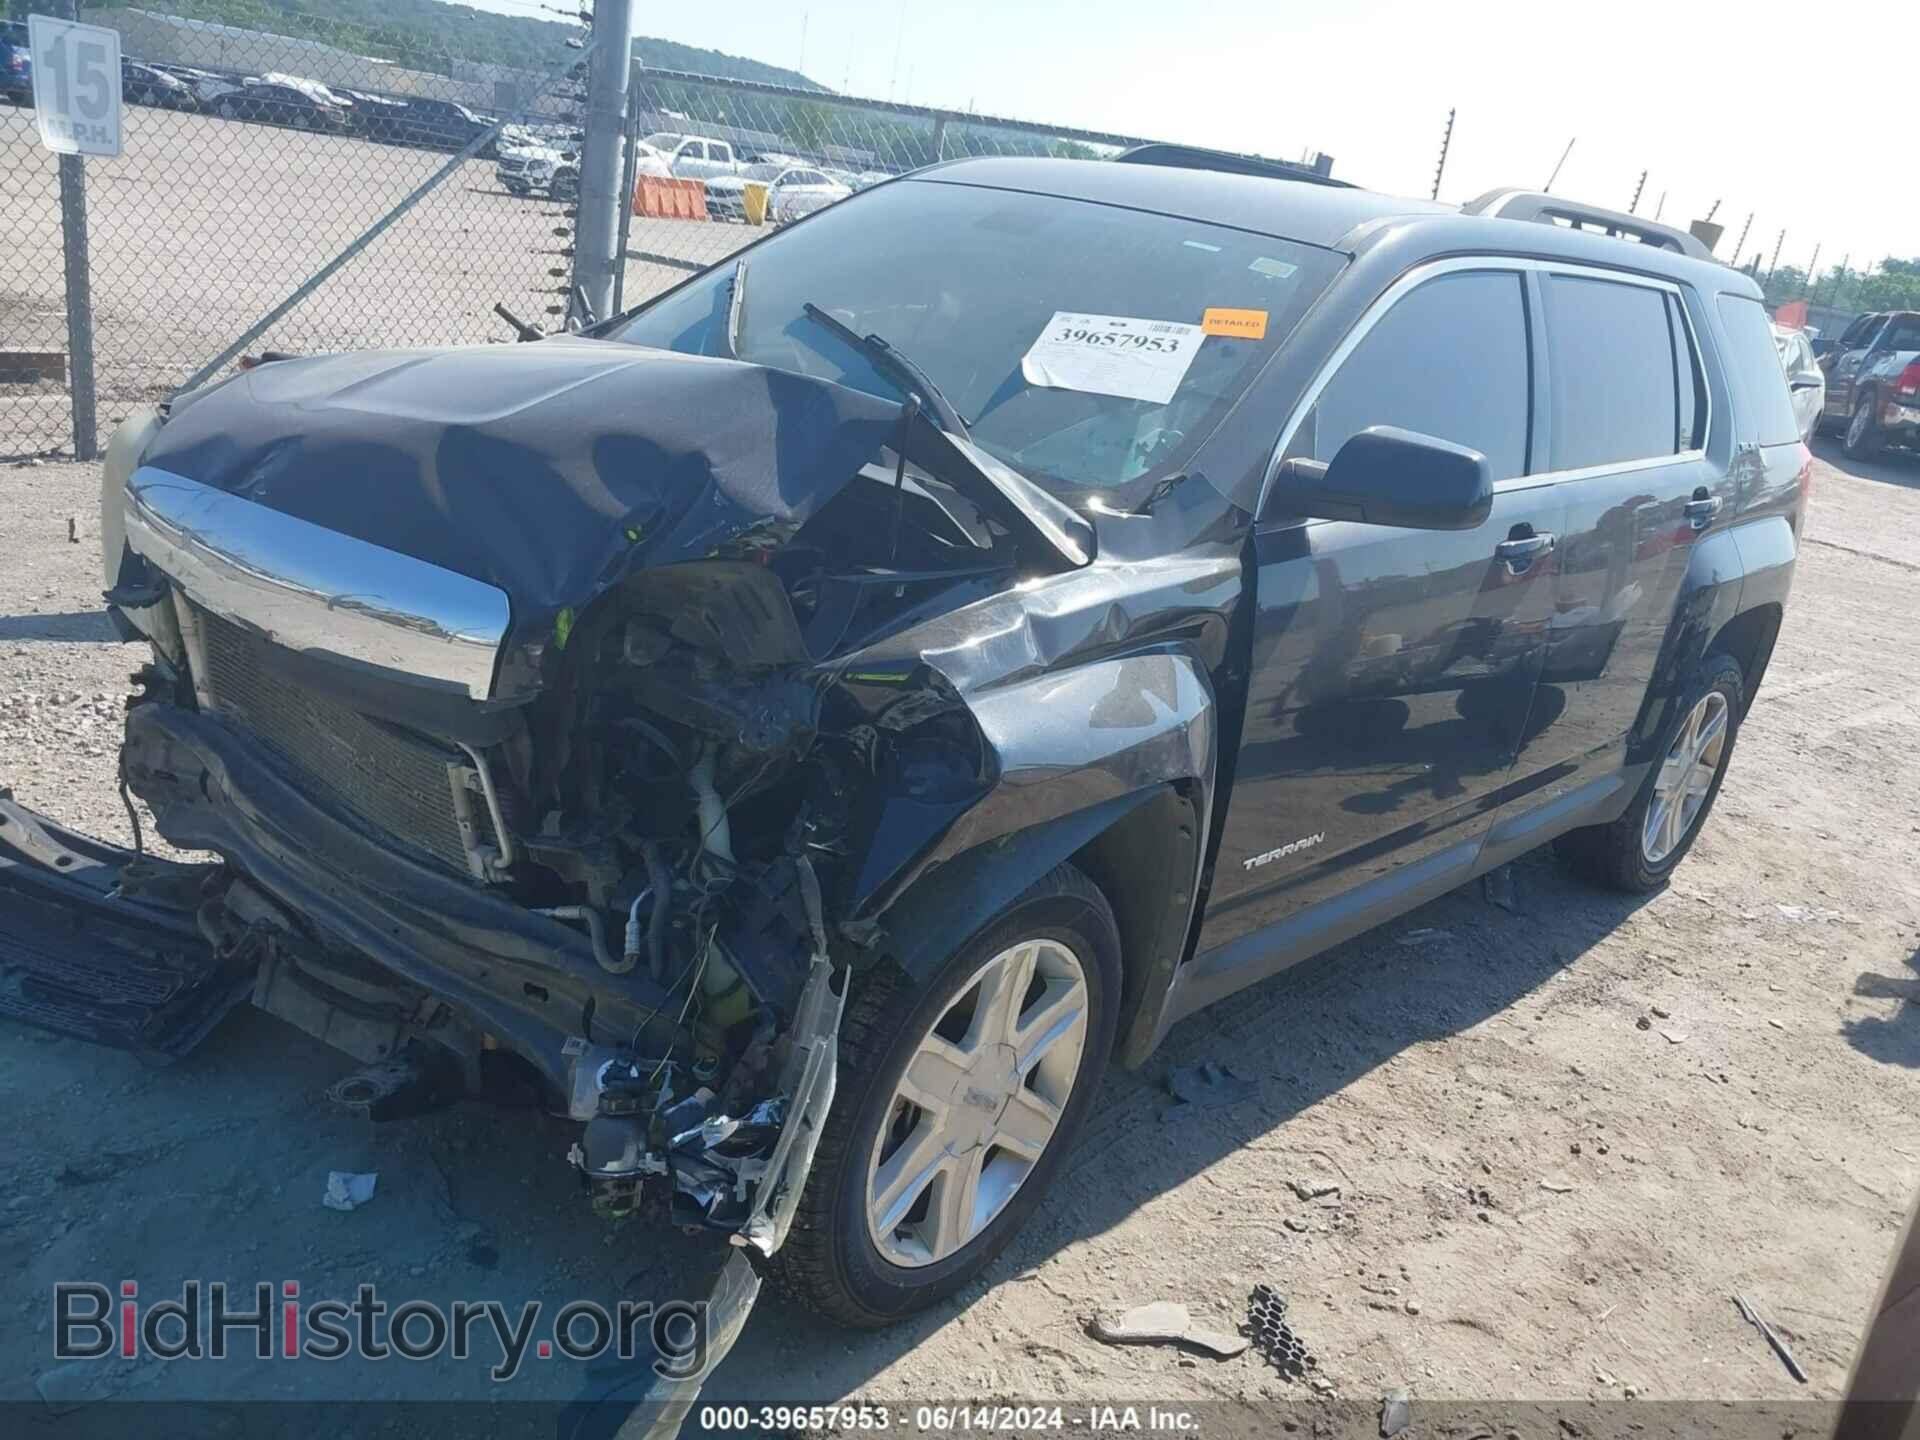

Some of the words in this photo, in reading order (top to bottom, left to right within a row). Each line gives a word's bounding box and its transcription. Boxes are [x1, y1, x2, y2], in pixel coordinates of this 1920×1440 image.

[44, 35, 110, 120] 15
[1054, 327, 1180, 353] 39657953
[1208, 318, 1261, 329] DETAILED
[1242, 831, 1326, 871] TERRAIN
